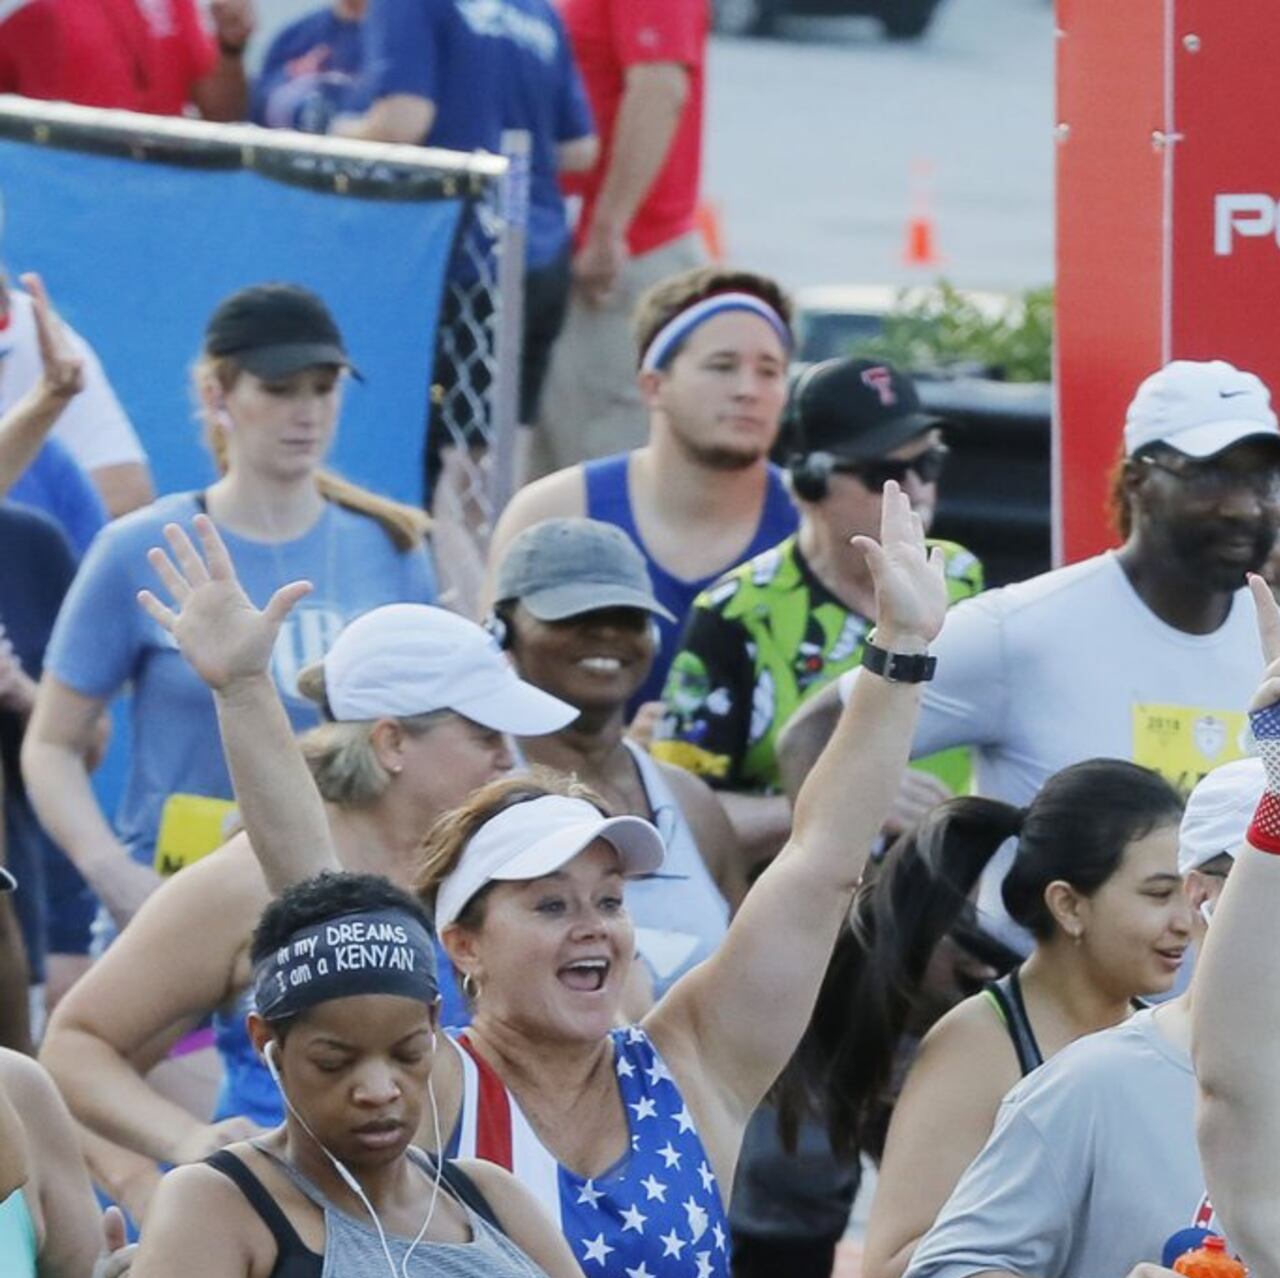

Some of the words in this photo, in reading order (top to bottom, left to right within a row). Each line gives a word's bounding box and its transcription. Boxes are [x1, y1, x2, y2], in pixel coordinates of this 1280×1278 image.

[326, 923, 408, 946] DREAMS
[276, 970, 287, 993] I
[290, 964, 312, 986] am
[317, 957, 328, 975] a
[335, 944, 414, 972] KENYAN
